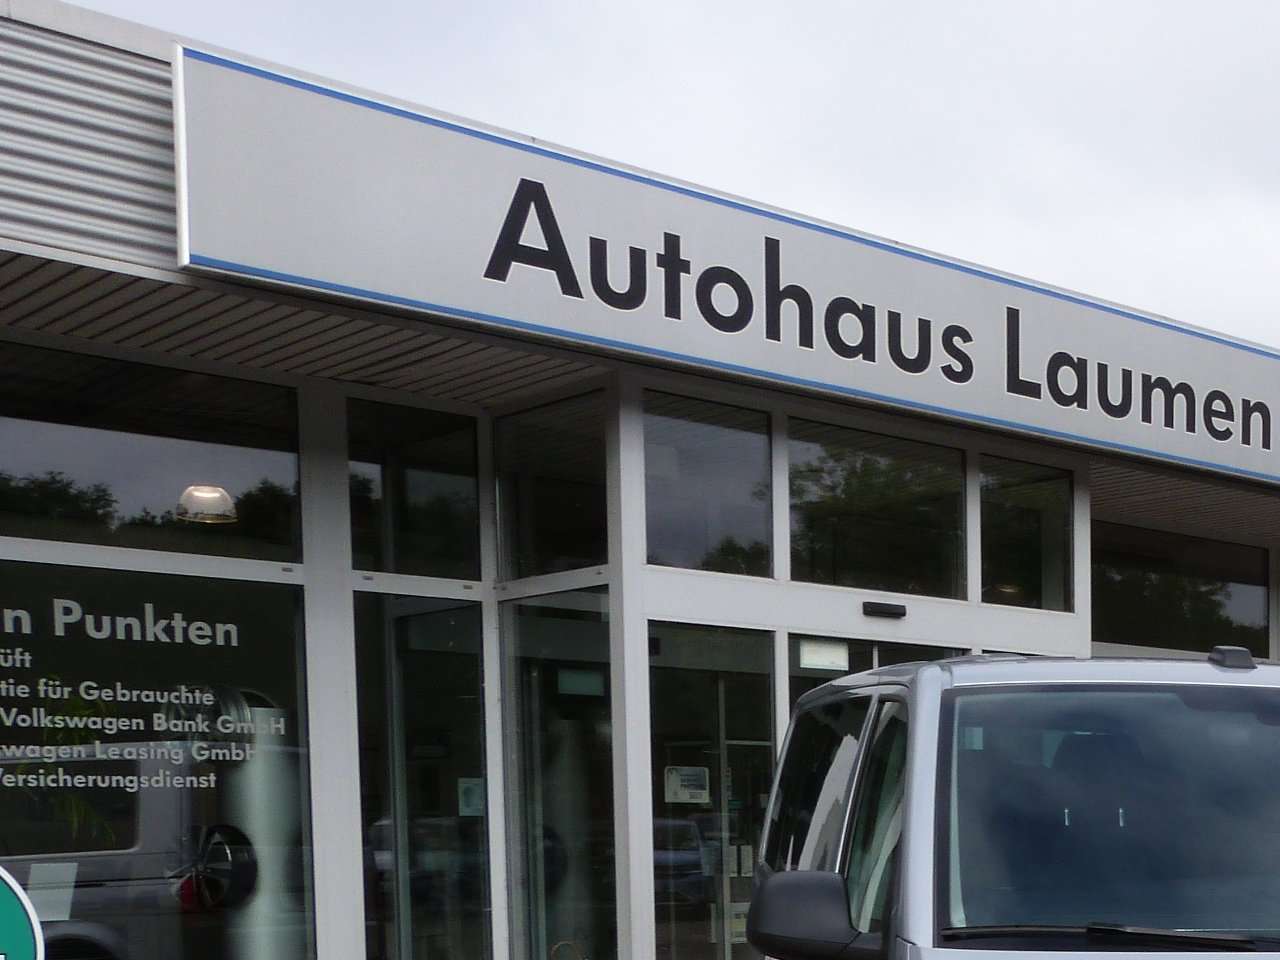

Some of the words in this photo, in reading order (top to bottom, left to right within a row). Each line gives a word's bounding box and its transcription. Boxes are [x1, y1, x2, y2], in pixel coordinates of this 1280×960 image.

[483, 178, 975, 385] Autohaus
[1005, 306, 1273, 452] Laumen
[53, 598, 239, 646] Punkten
[38, 677, 72, 700] für
[79, 680, 215, 706] Gebrauchte
[0, 708, 145, 734] Volkswagen
[153, 714, 210, 734] Bank
[95, 740, 184, 765] Leasing
